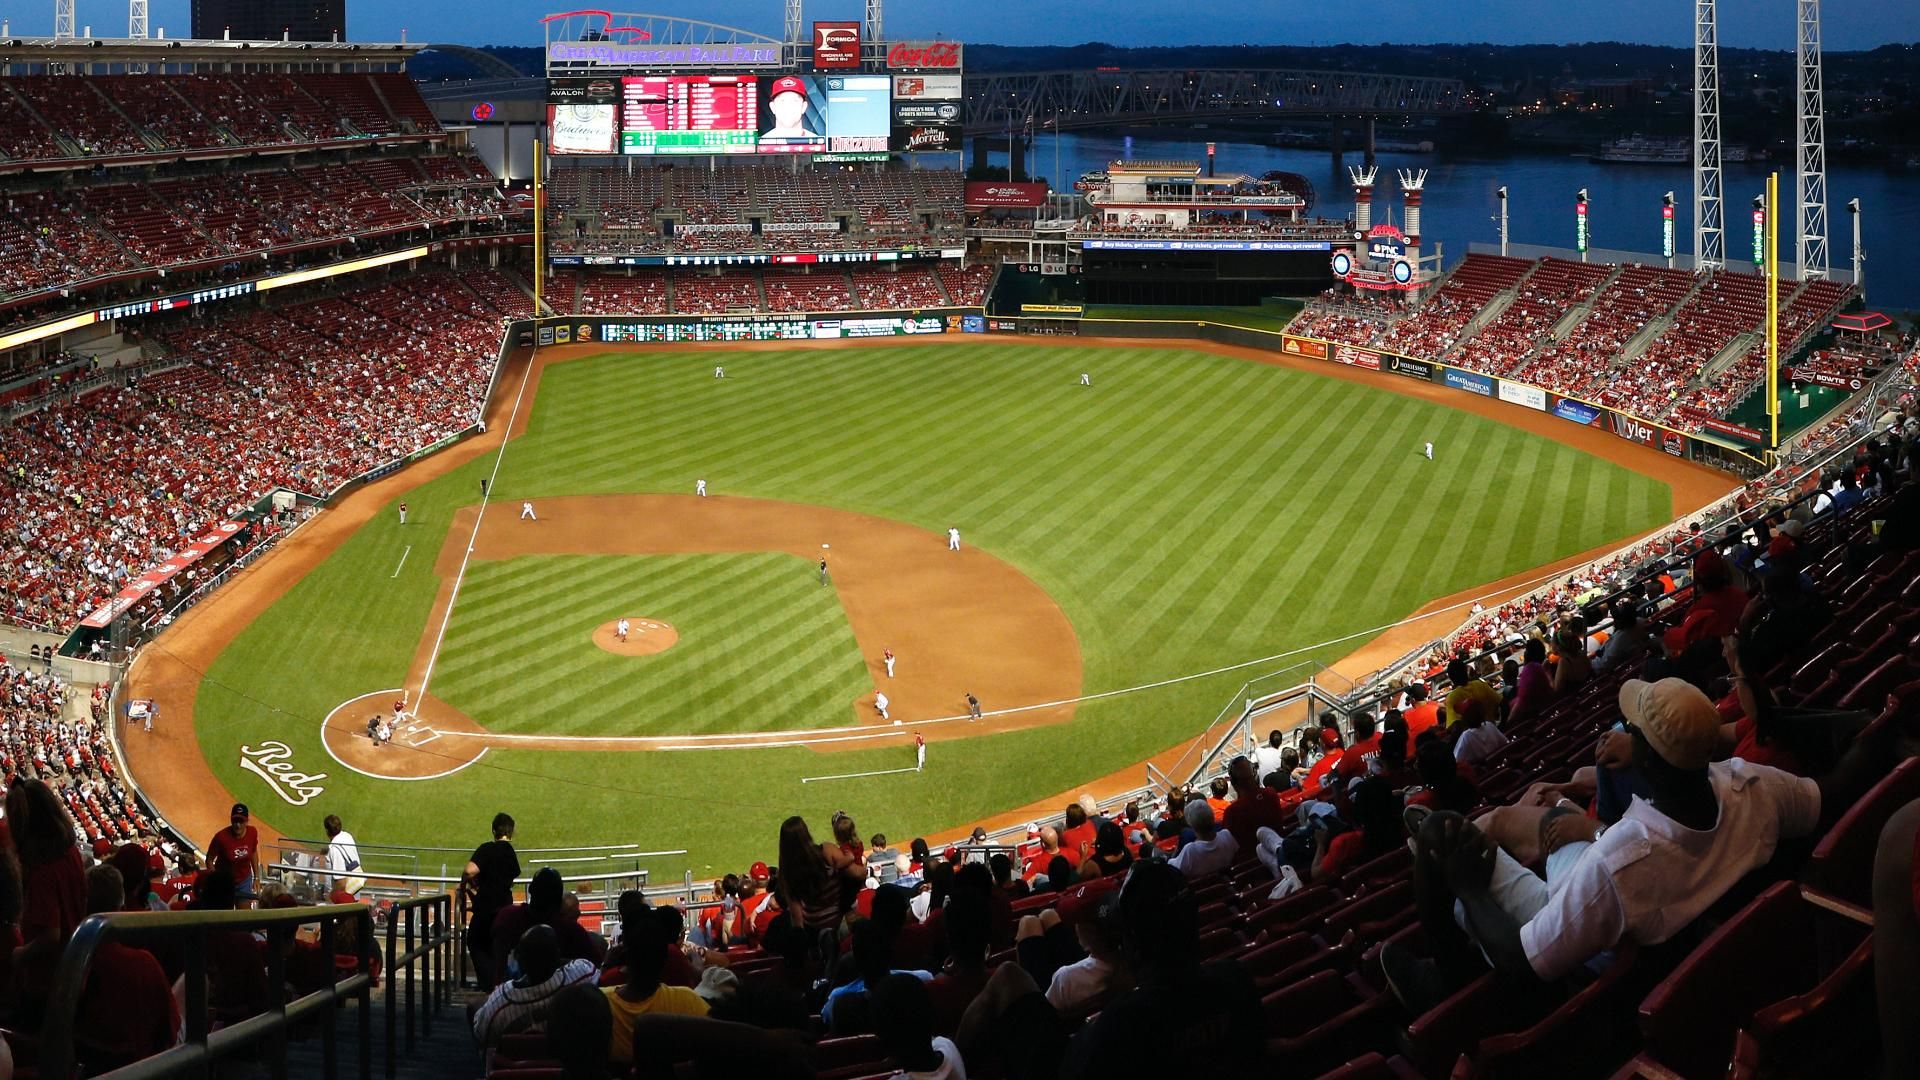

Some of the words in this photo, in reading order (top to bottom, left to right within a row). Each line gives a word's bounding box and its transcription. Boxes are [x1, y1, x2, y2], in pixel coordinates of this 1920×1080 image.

[687, 47, 730, 63] BALL
[732, 47, 777, 62] PARK
[905, 131, 950, 150] Morrell
[1381, 245, 1399, 255] PNC
[1447, 373, 1467, 386] GREAT
[1463, 378, 1489, 392] AMERICAN
[1816, 374, 1846, 384] BOWTIE
[240, 741, 328, 806] Reds
